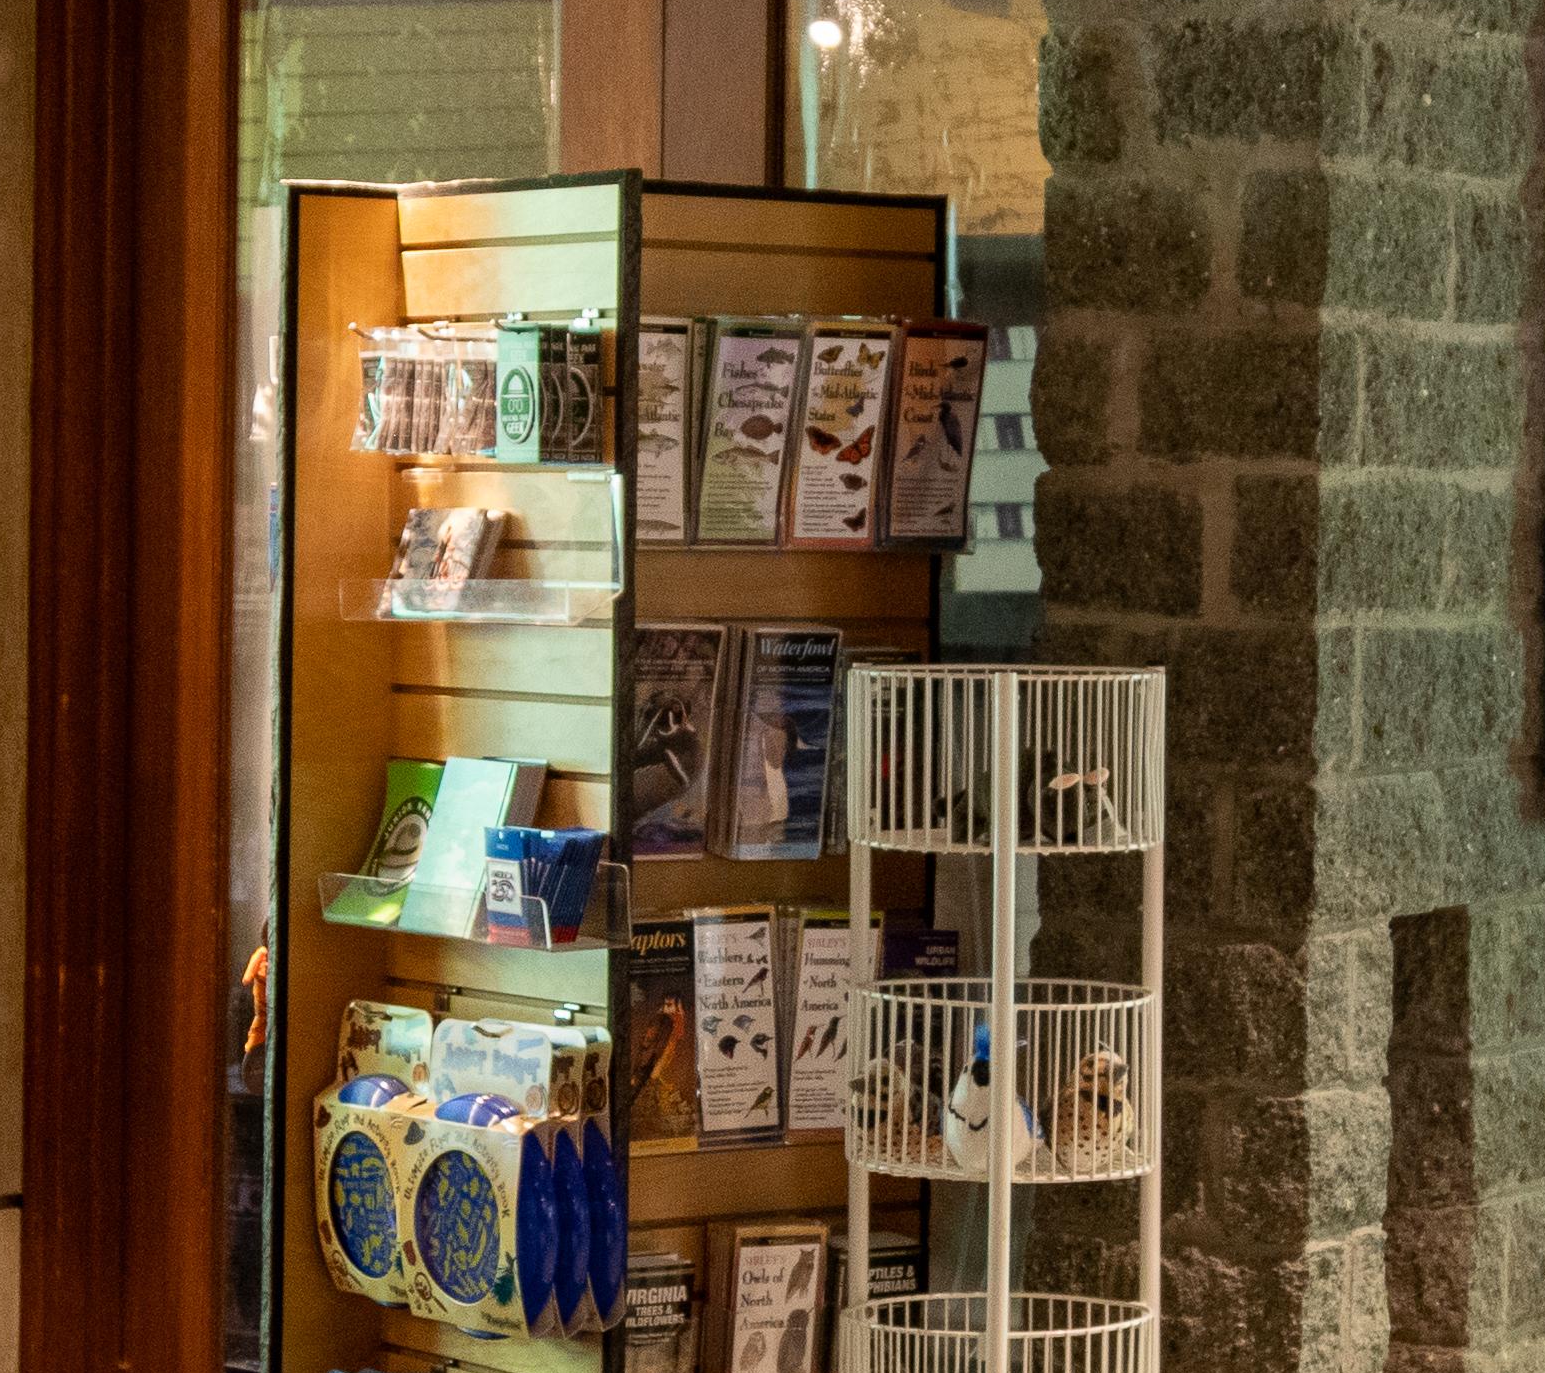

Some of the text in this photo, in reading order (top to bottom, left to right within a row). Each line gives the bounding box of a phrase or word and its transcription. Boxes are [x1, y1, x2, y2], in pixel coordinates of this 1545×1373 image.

[718, 390, 784, 414] Chesapeake
[759, 638, 836, 663] Waterfowl
[630, 931, 687, 956] aptors
[809, 973, 837, 989] North
[699, 993, 771, 1010] North America
[801, 999, 839, 1012] America
[741, 1266, 786, 1285] Owls of
[868, 1265, 903, 1280] PTILES
[867, 1278, 917, 1294] PHIBIANS
[740, 1289, 773, 1308] North
[739, 1315, 785, 1331] America
